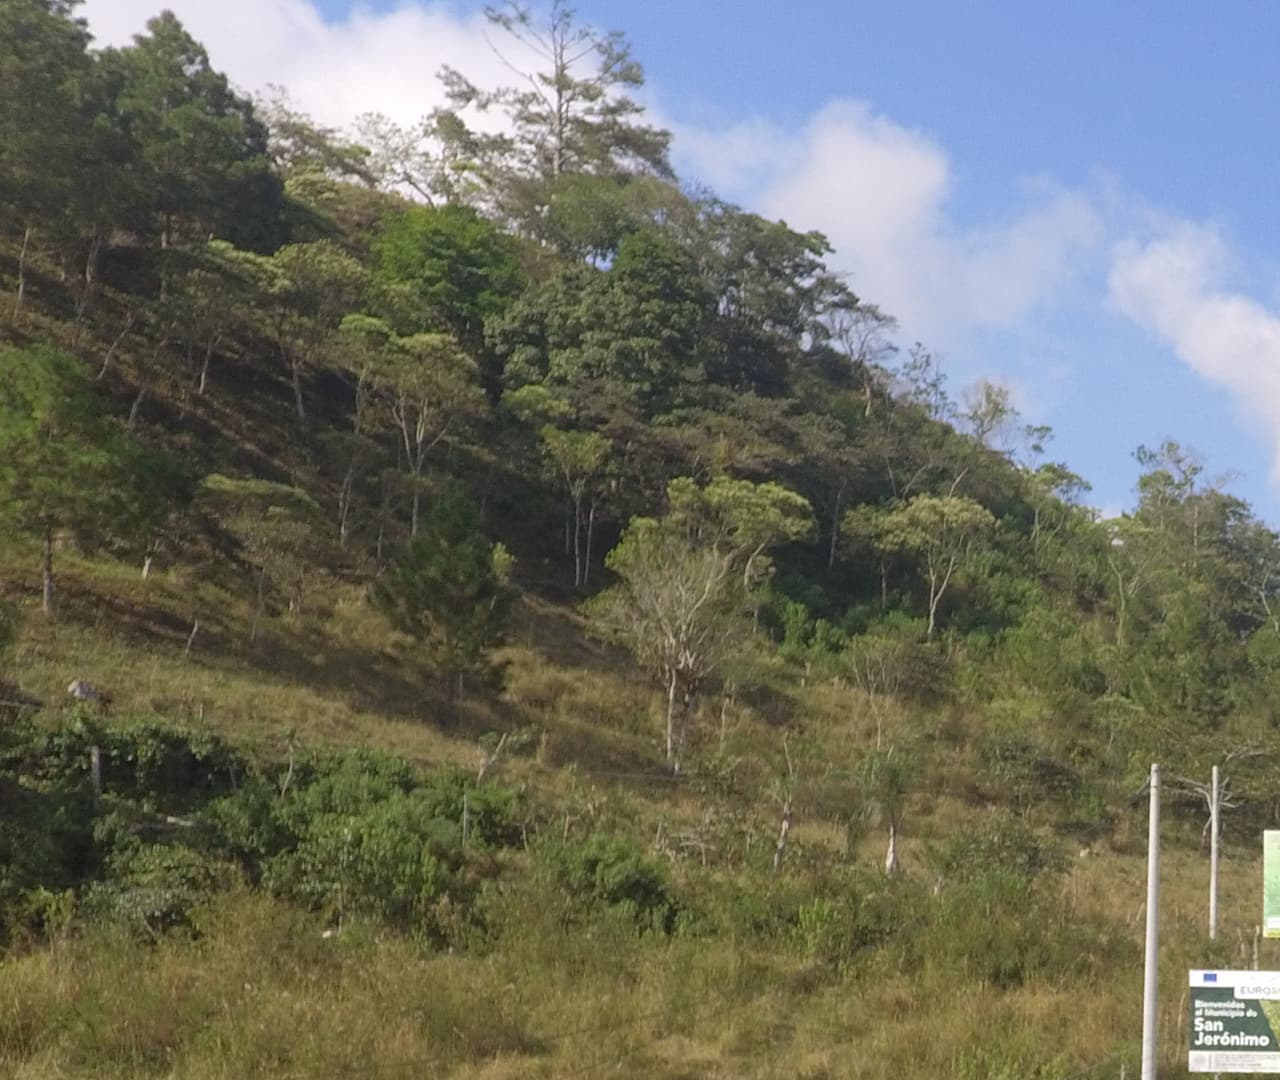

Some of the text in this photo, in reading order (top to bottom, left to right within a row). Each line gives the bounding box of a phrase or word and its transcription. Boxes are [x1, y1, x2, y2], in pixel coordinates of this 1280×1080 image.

[1194, 999, 1246, 1009] Bienvenidos
[1194, 1008, 1258, 1018] al Municipio de
[1194, 1017, 1224, 1032] San
[1194, 1031, 1270, 1047] Jerónimo
